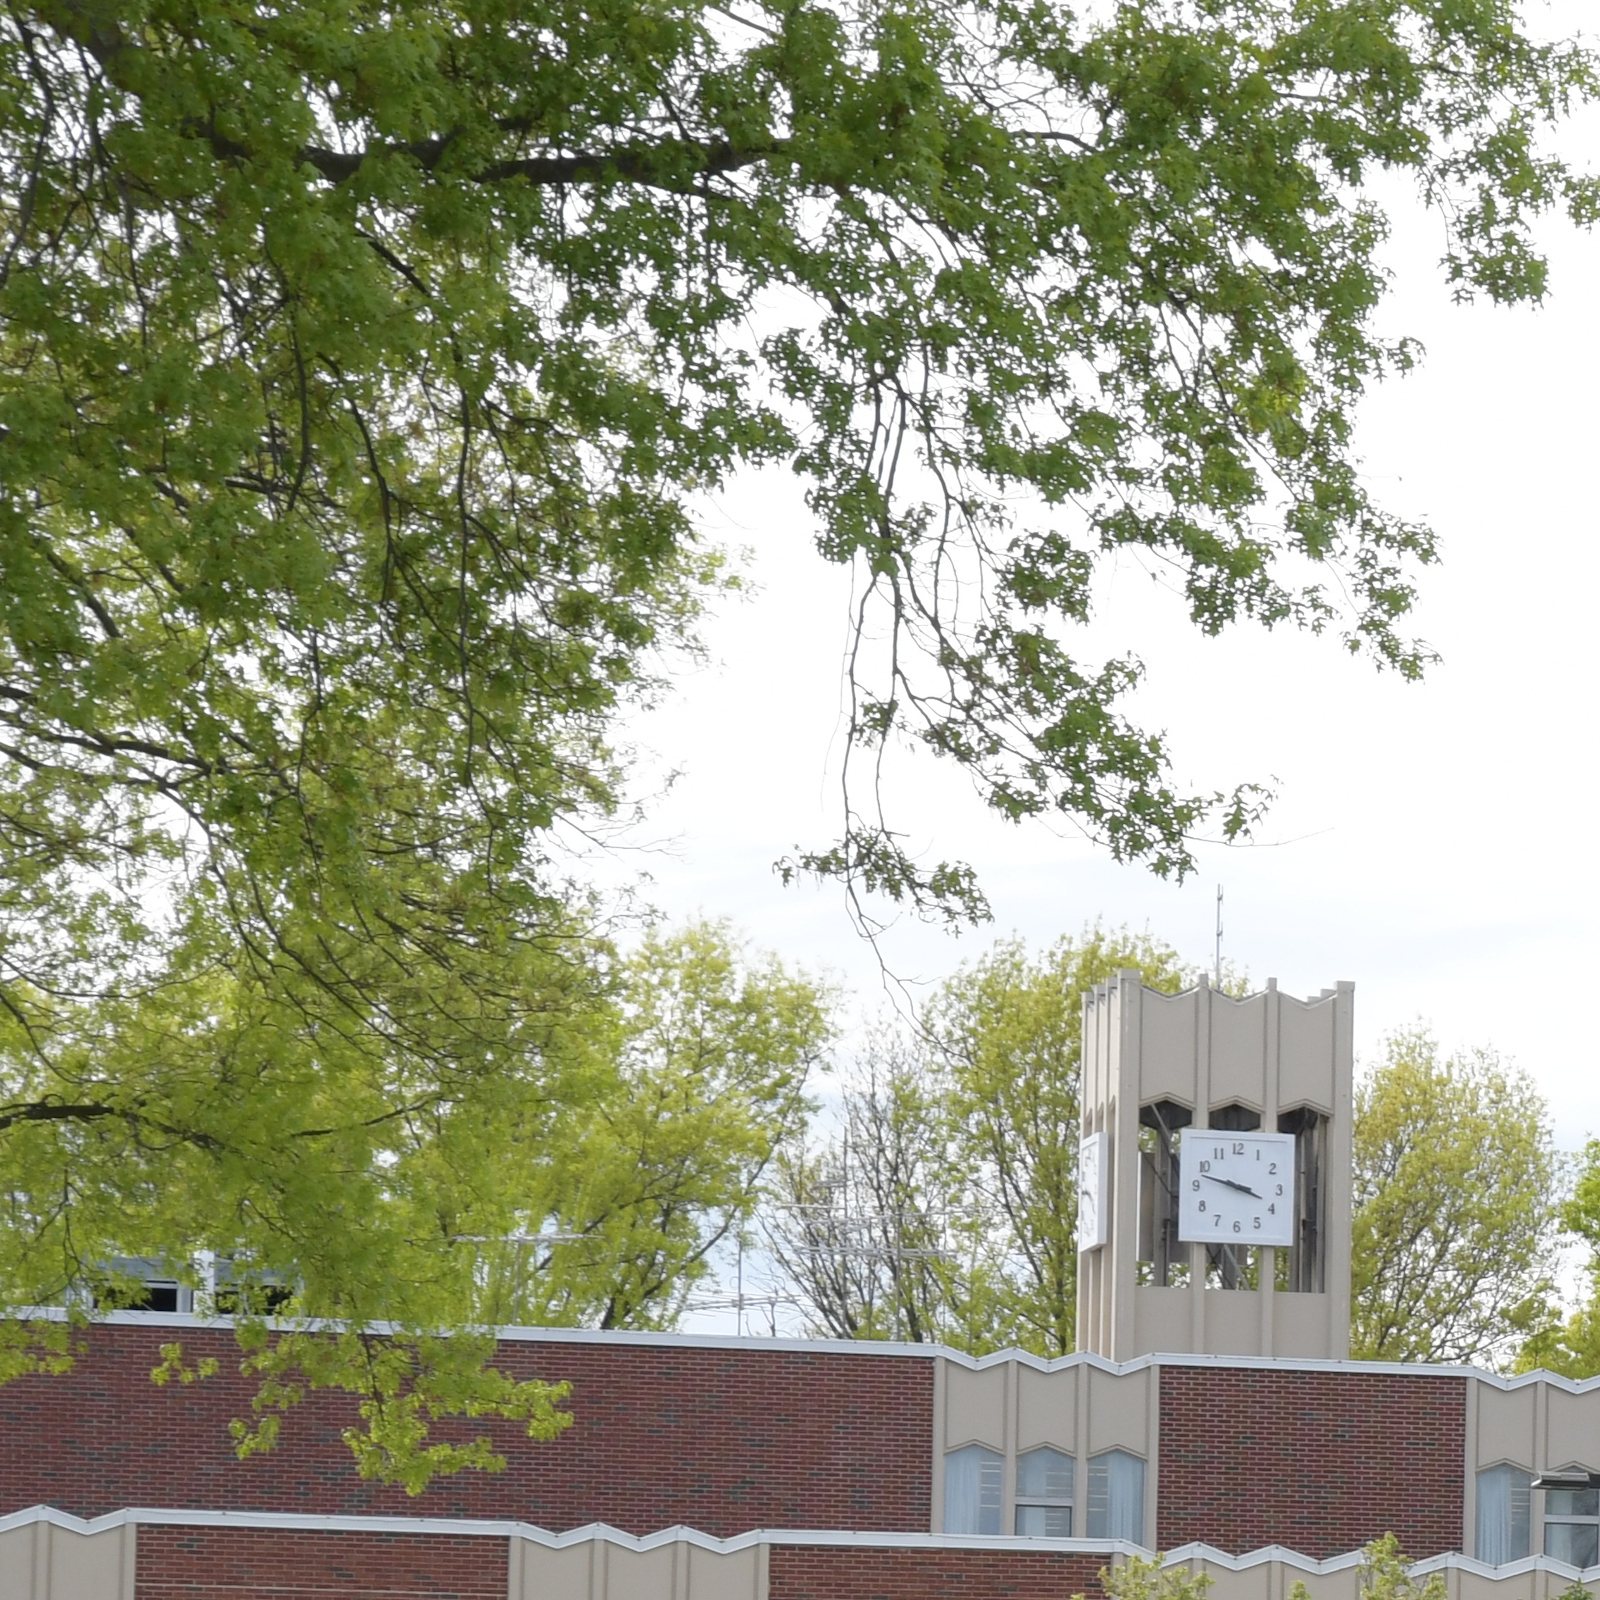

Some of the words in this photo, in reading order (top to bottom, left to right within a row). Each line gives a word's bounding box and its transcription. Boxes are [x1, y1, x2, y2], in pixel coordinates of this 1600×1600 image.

[1213, 1148, 1224, 1160] 11
[1232, 1143, 1245, 1155] 12
[1199, 1160, 1211, 1173] 10
[1268, 1163, 1277, 1175] 2
[1192, 1179, 1200, 1192] 9
[1275, 1184, 1283, 1196] 3
[1198, 1200, 1206, 1212] 8
[1267, 1203, 1275, 1215] 4
[1213, 1215, 1221, 1227] 7
[1233, 1221, 1241, 1233] 6
[1253, 1217, 1261, 1229] 5
